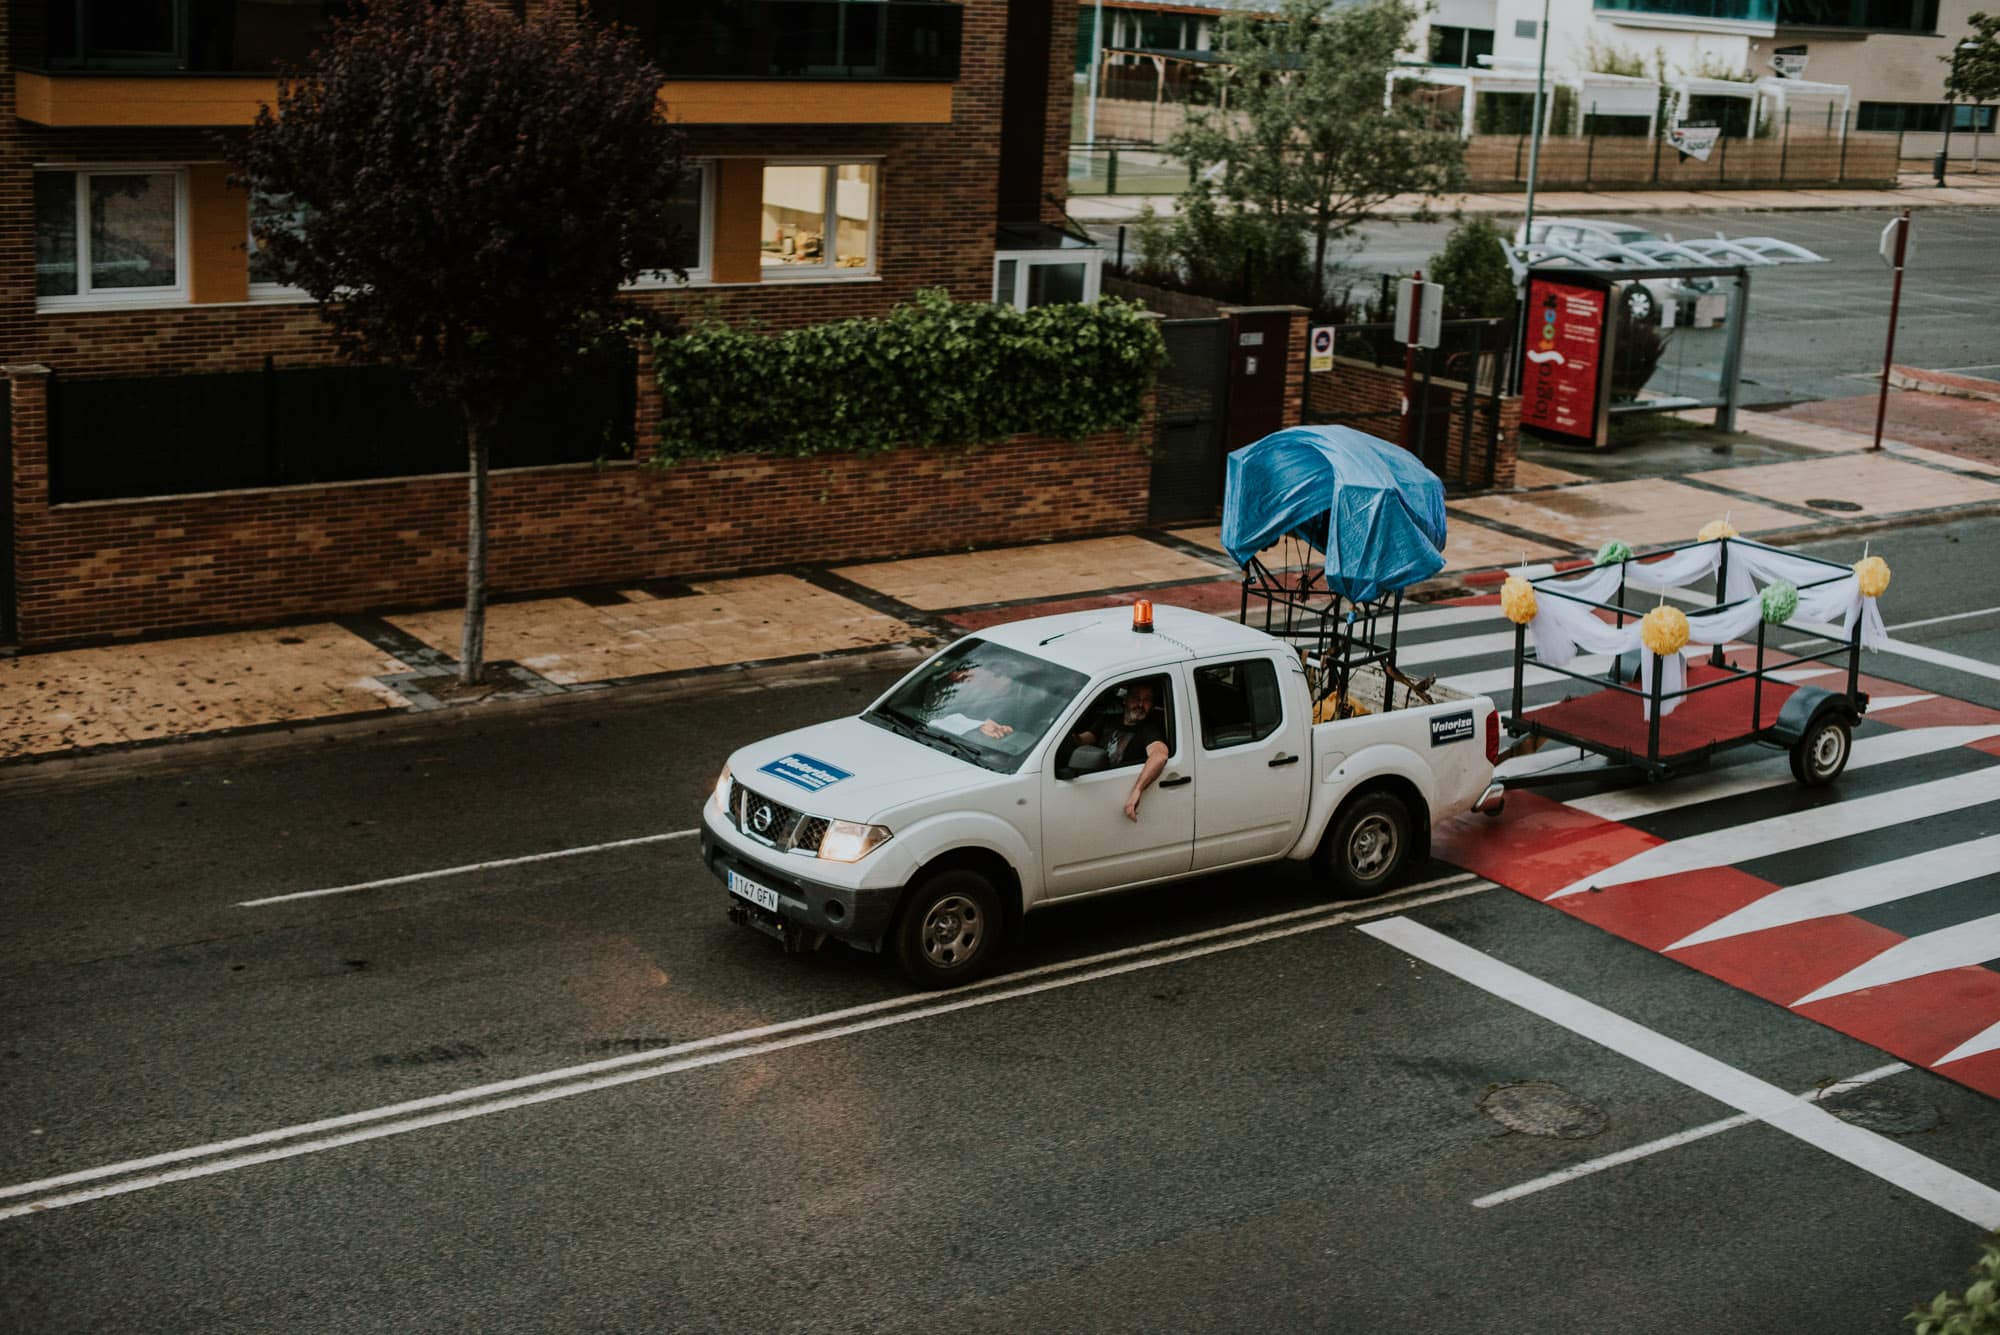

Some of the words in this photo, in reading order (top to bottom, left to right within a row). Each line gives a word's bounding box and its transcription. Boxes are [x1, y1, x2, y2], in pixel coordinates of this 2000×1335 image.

[1432, 719, 1472, 733] Valoriza
[735, 876, 755, 898] 1147
[757, 888, 775, 908] GFN
